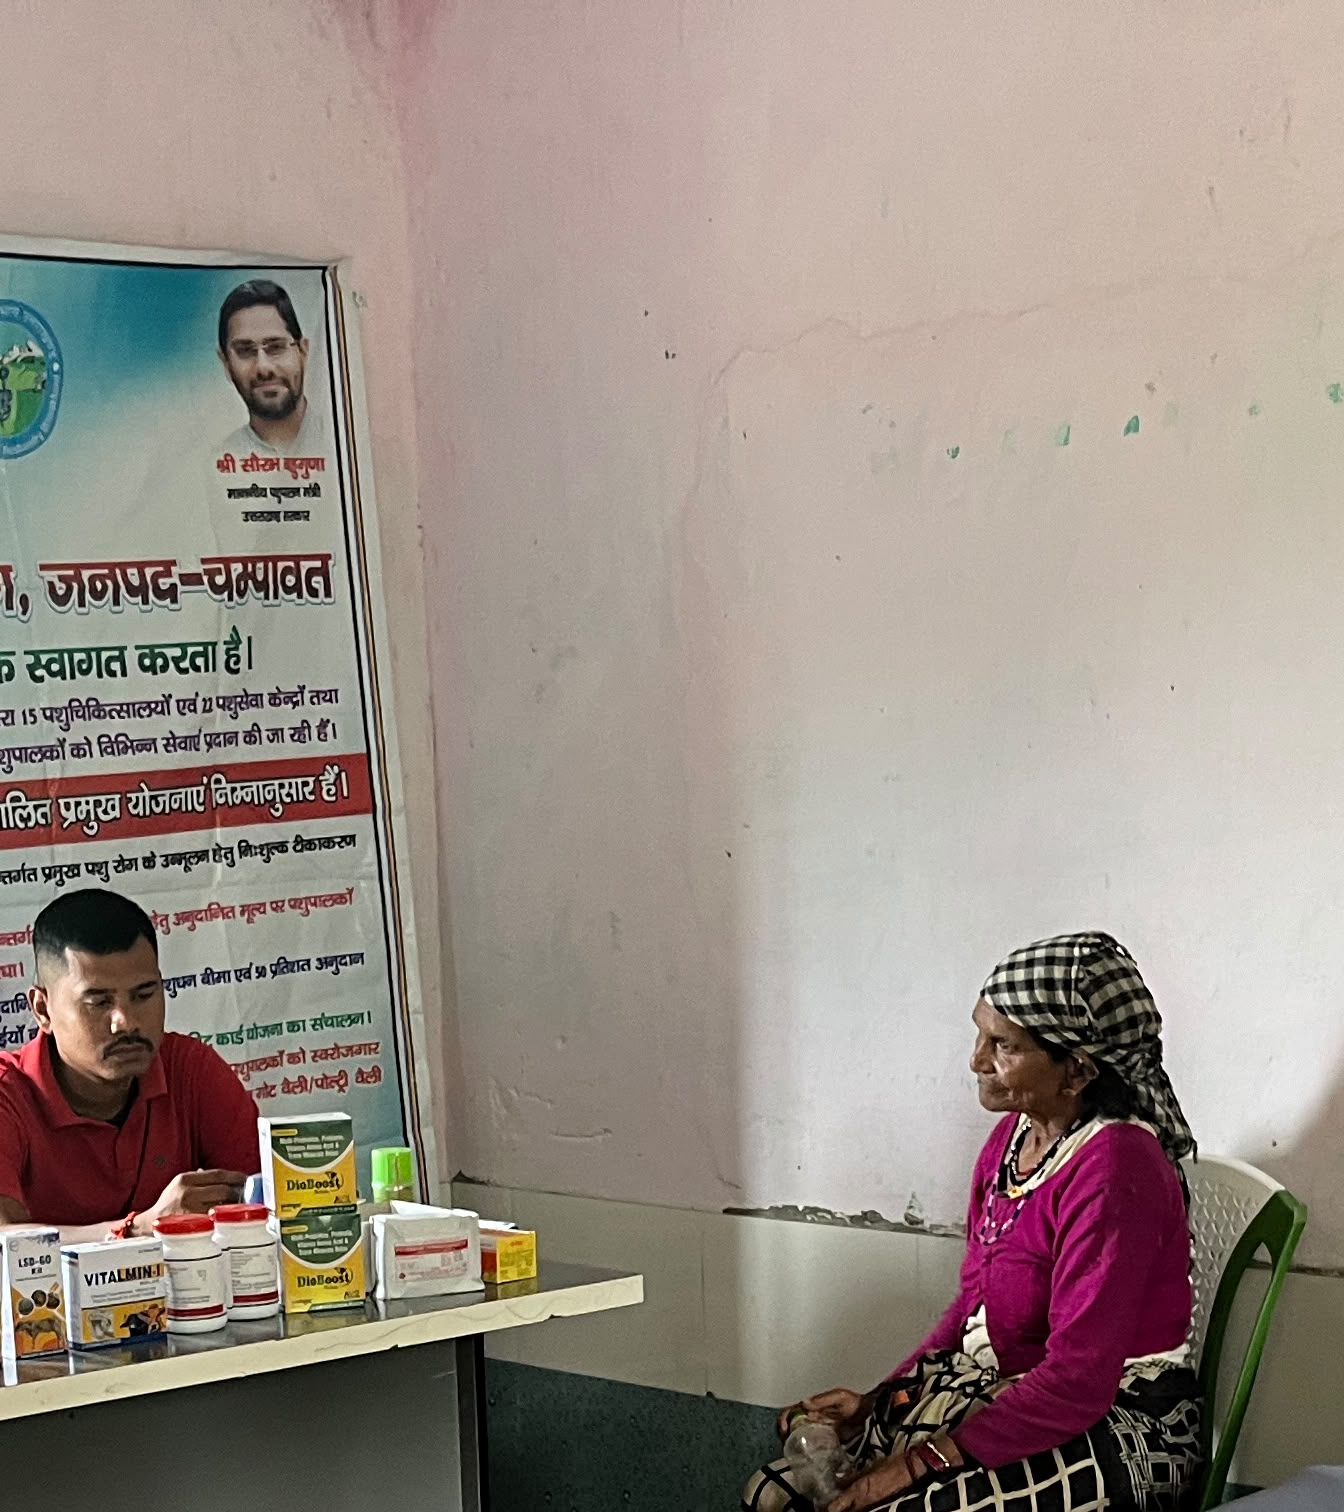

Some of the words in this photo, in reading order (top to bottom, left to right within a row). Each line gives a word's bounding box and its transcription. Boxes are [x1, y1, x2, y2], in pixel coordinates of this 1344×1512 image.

[217, 453, 235, 473] श्री
[24, 646, 127, 683] स्वागत
[134, 641, 217, 676] करता
[21, 709, 36, 726] 15
[43, 695, 171, 730] पशुचिकित्सालयों
[176, 692, 199, 716] एवं
[216, 688, 264, 719] पशुसेवा
[309, 689, 338, 705] तथा
[71, 737, 91, 759] को
[98, 734, 158, 757] विभिन्न
[204, 731, 238, 752] प्रदान
[243, 723, 262, 745] की
[265, 728, 284, 743] जा
[288, 720, 311, 743] रही
[59, 794, 120, 835] प्रमुख
[211, 773, 314, 817] निम्नानुसार
[42, 863, 80, 886] प्रमुख
[86, 862, 109, 881] पशु
[114, 855, 138, 873] रोग
[143, 852, 156, 870] के
[270, 900, 285, 913] पर
[316, 952, 364, 975] अनुदान
[216, 1024, 244, 1046] कार्ड
[286, 1019, 306, 1033] का
[287, 1047, 306, 1065] को
